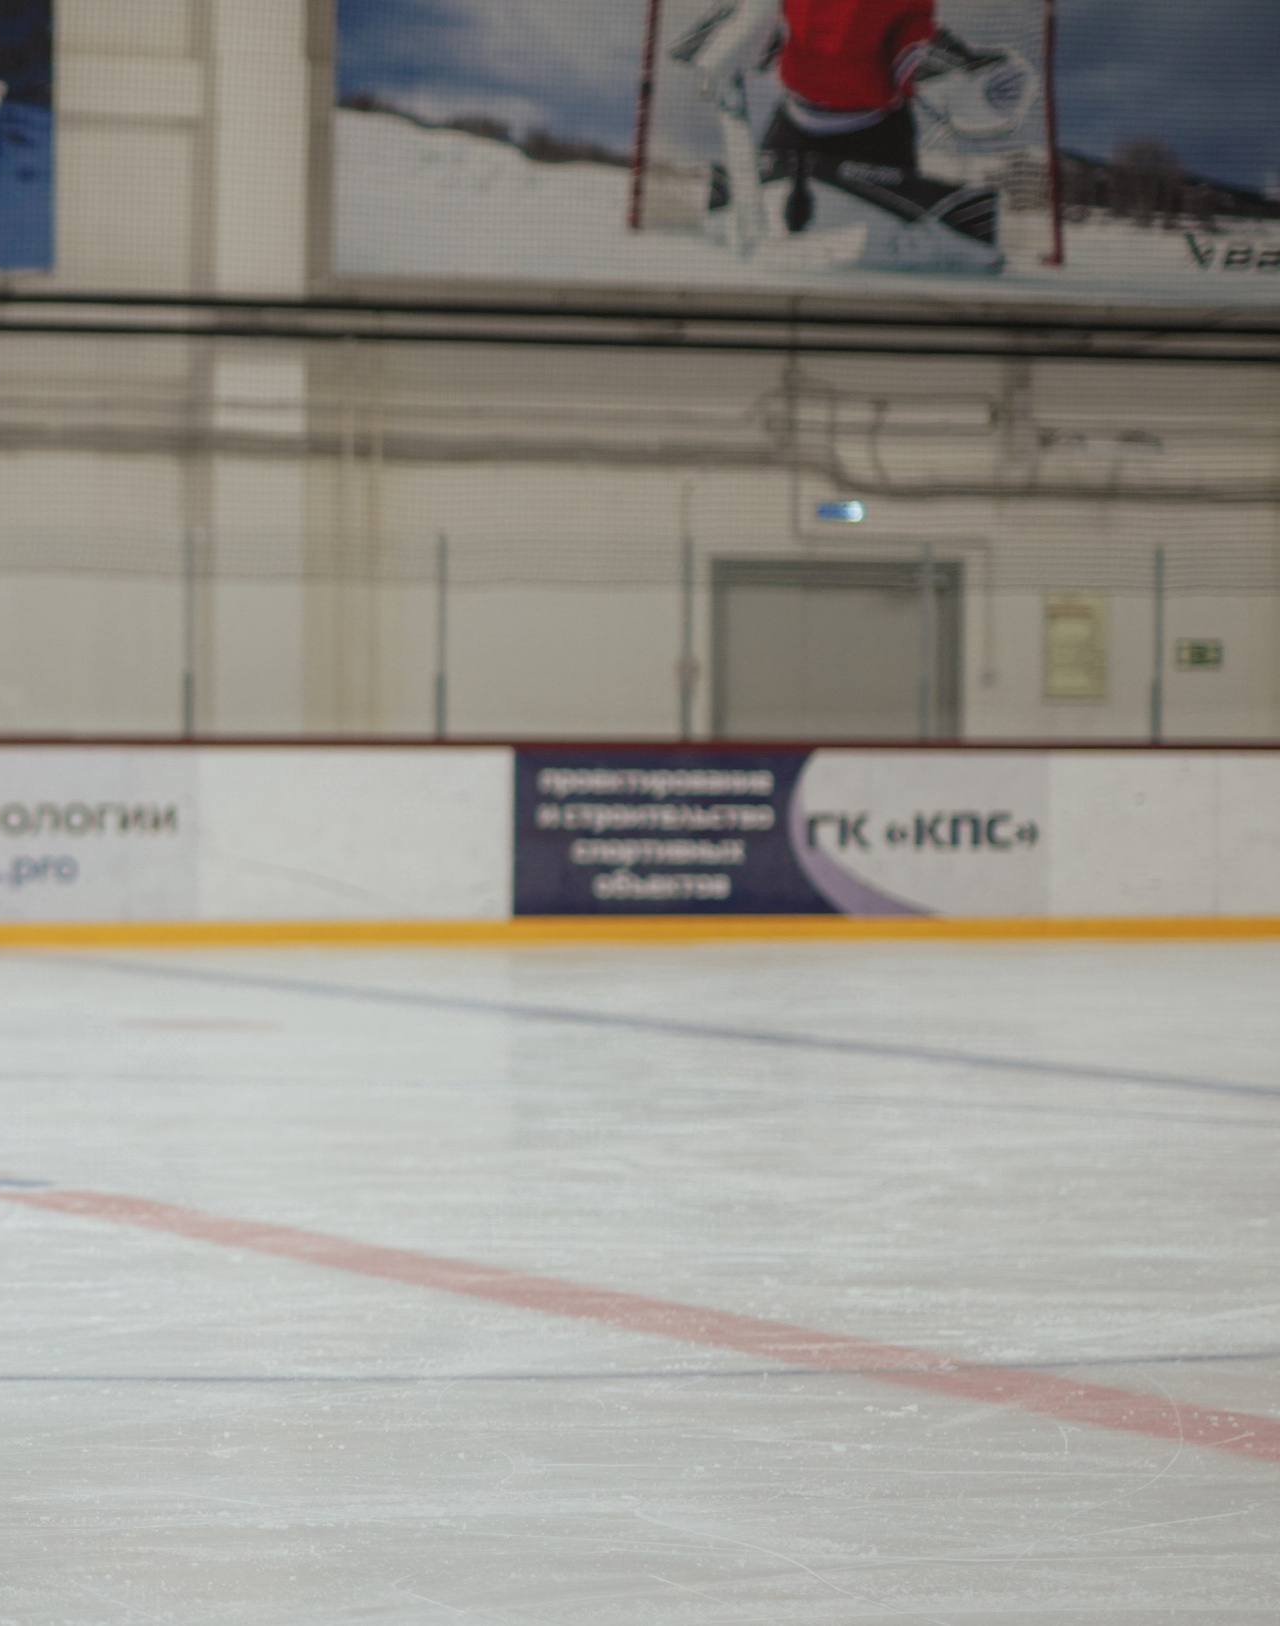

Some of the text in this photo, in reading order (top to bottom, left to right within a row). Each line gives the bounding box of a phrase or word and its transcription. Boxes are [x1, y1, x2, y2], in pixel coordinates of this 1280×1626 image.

[564, 803, 775, 833] строительство
[806, 814, 869, 848] ГК
[571, 838, 747, 867] спортивных
[591, 868, 732, 900] объектов
